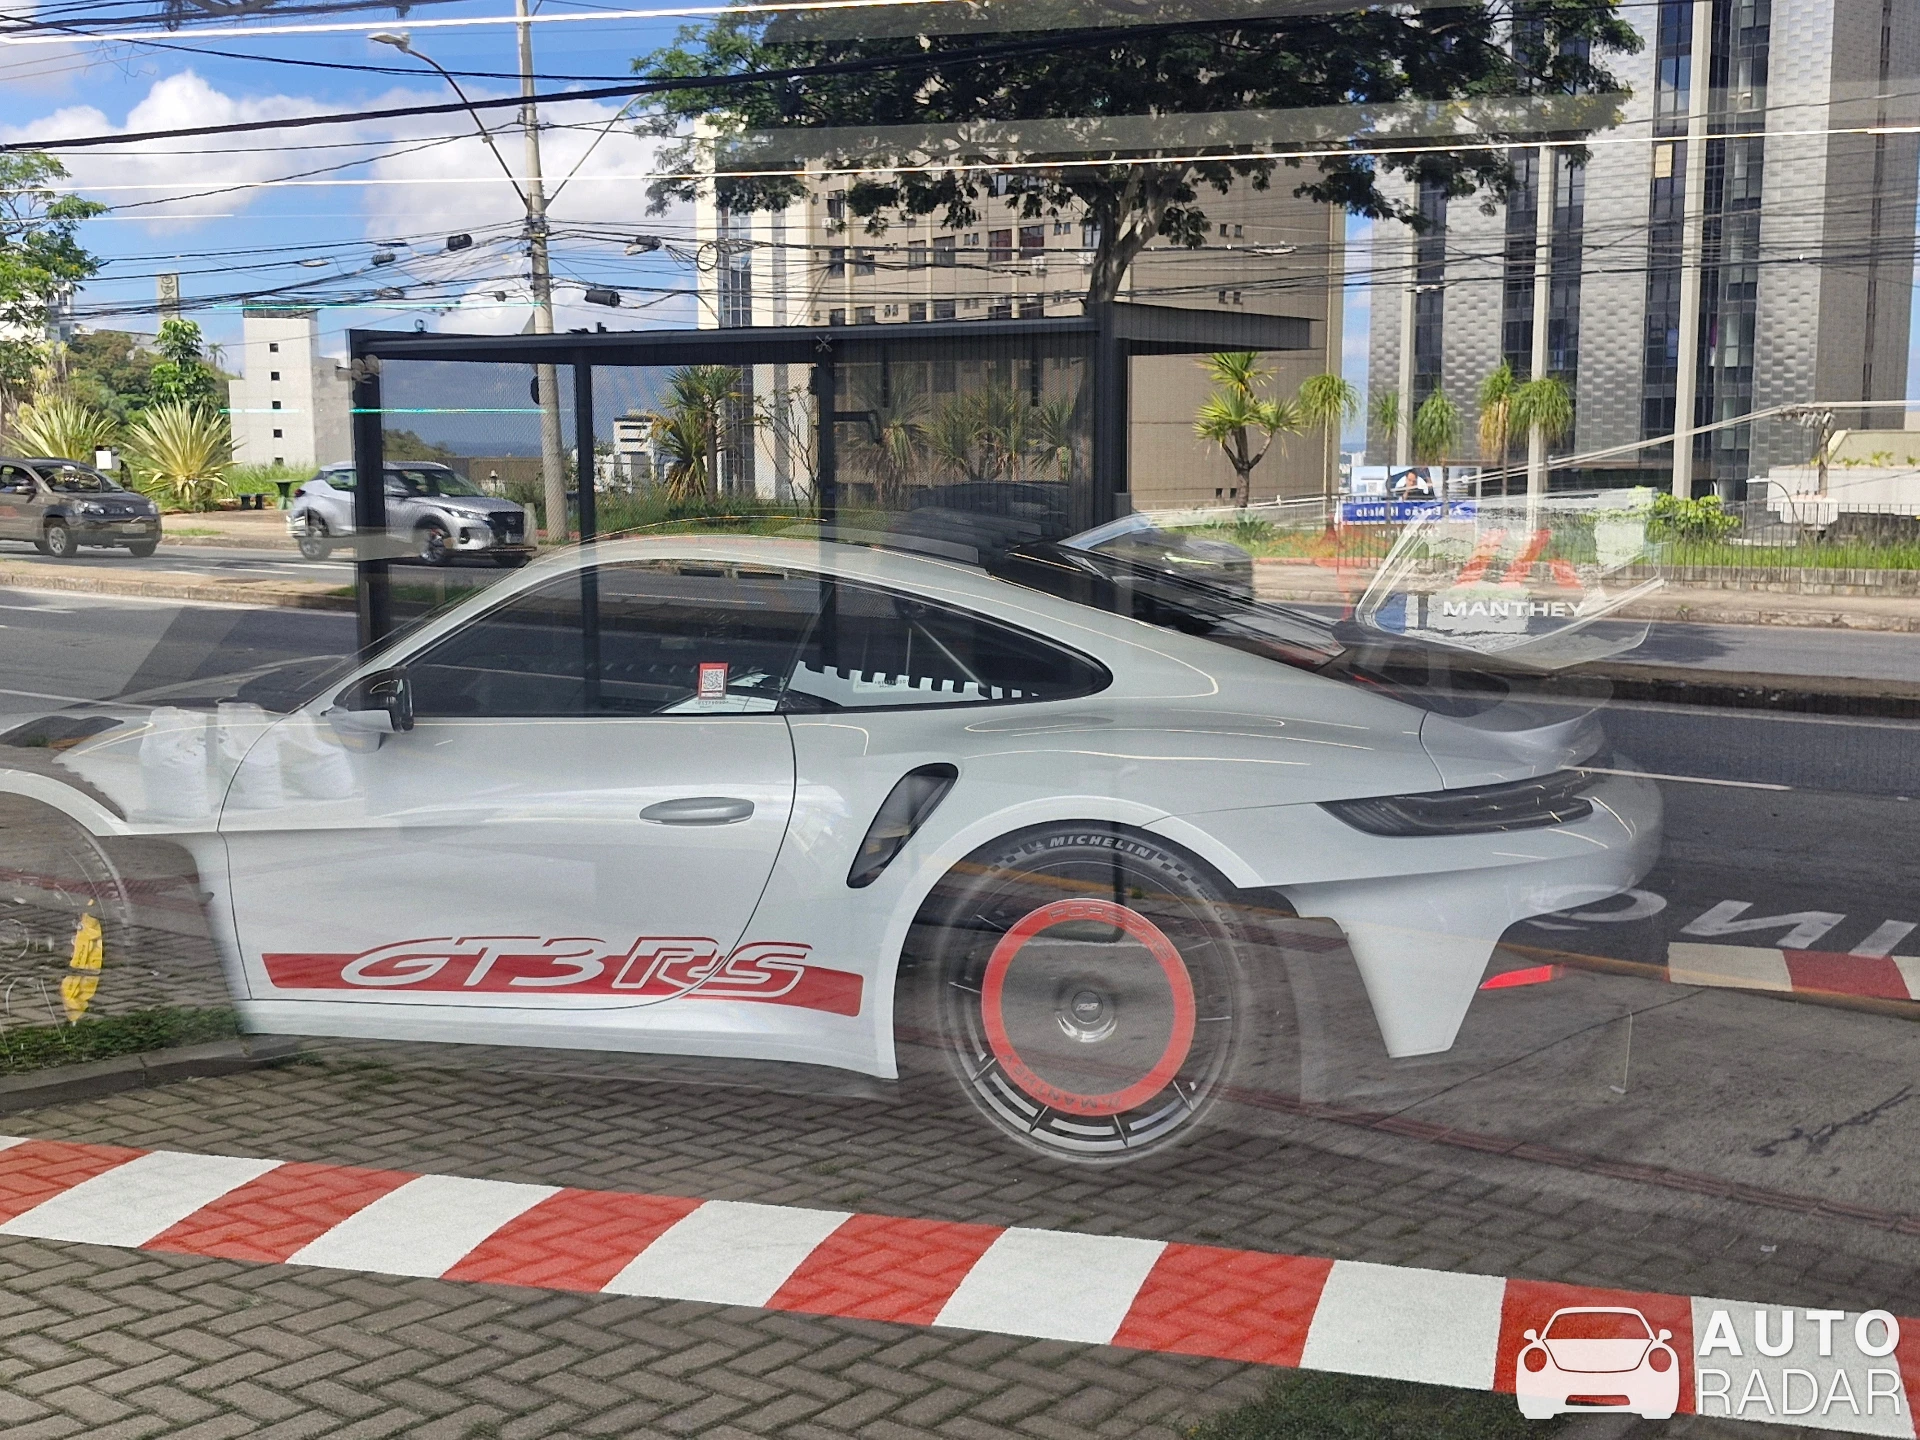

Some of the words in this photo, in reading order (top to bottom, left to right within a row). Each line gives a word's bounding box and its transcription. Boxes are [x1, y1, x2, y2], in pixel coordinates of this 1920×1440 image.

[1443, 601, 1584, 617] MANTHEY
[1049, 834, 1152, 858] MICHELIN
[1002, 1054, 1098, 1109] MANTHEY
